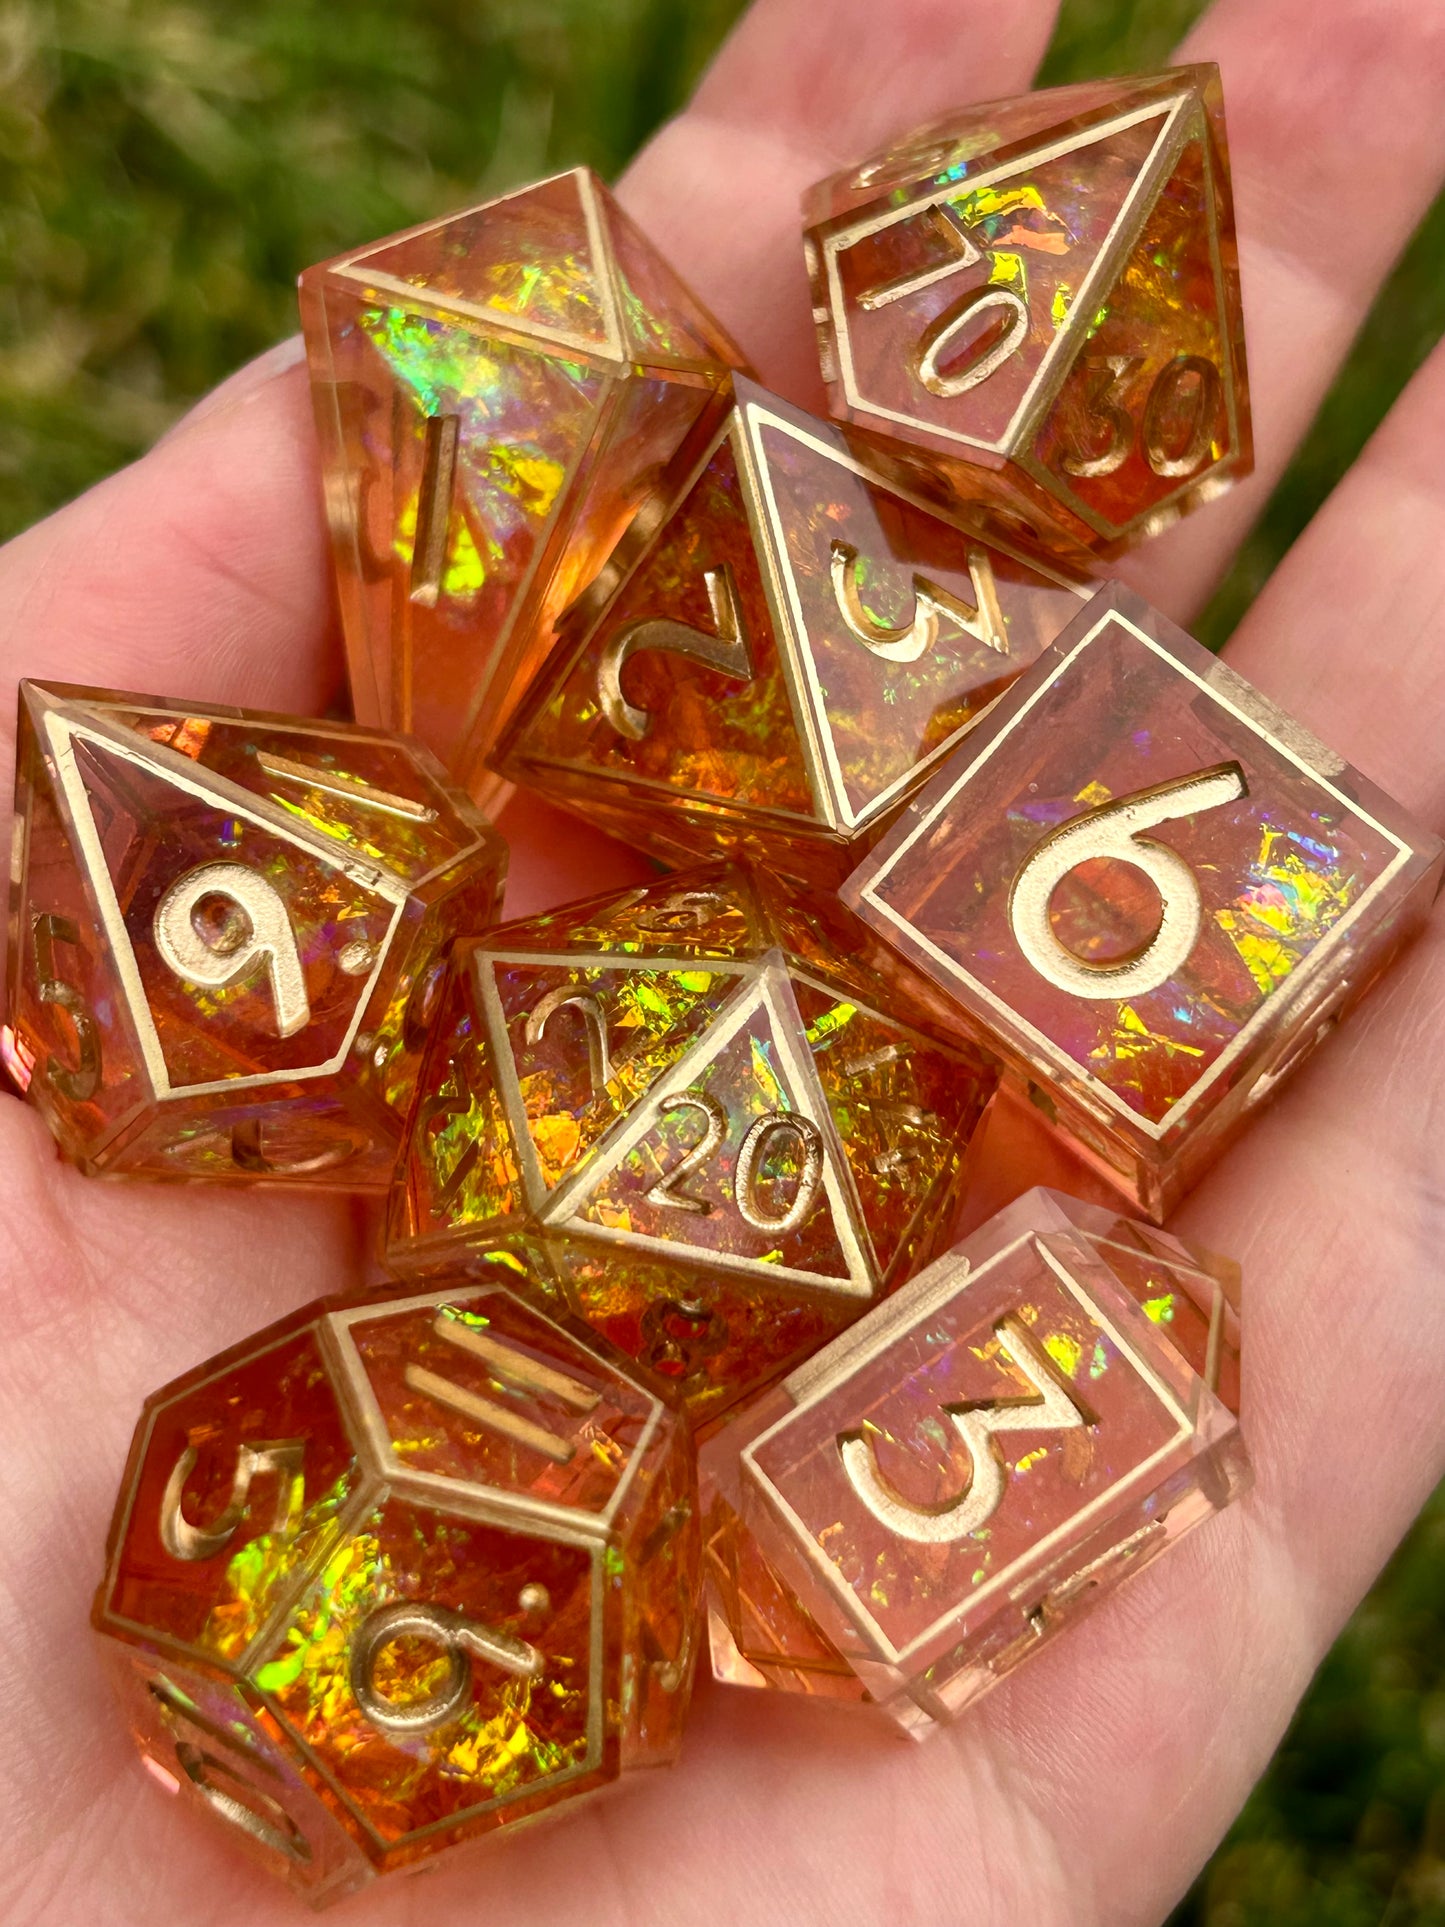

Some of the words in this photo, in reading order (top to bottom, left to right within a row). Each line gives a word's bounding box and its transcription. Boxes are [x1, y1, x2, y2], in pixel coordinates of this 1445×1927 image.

[856, 204, 1030, 397] 70
[1062, 354, 1222, 477] 30
[597, 562, 752, 742] 2
[830, 537, 1010, 663] 3
[1008, 760, 1247, 999] 6
[643, 1088, 825, 1235] 20
[404, 1320, 602, 1464] 11
[836, 1309, 1101, 1544] 3
